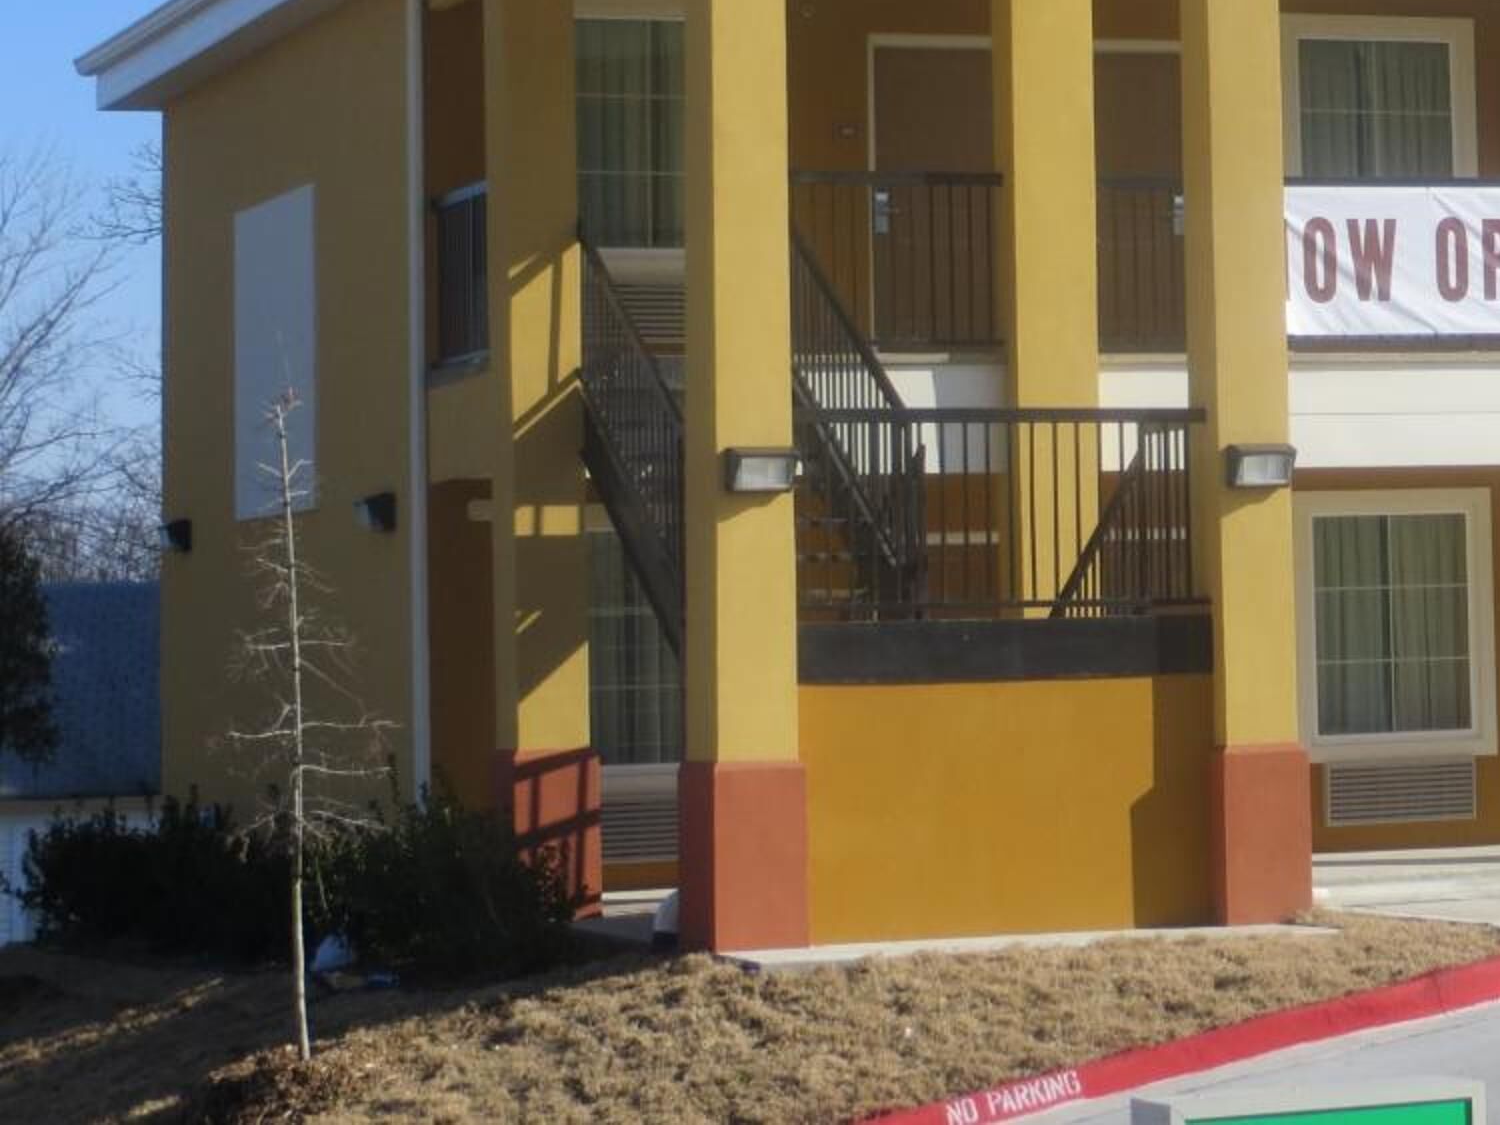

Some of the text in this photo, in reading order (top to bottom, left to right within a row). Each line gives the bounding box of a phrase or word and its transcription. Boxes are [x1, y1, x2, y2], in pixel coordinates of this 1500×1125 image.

[1285, 217, 1397, 303] OW
[946, 1070, 1081, 1125] NO PARKING
